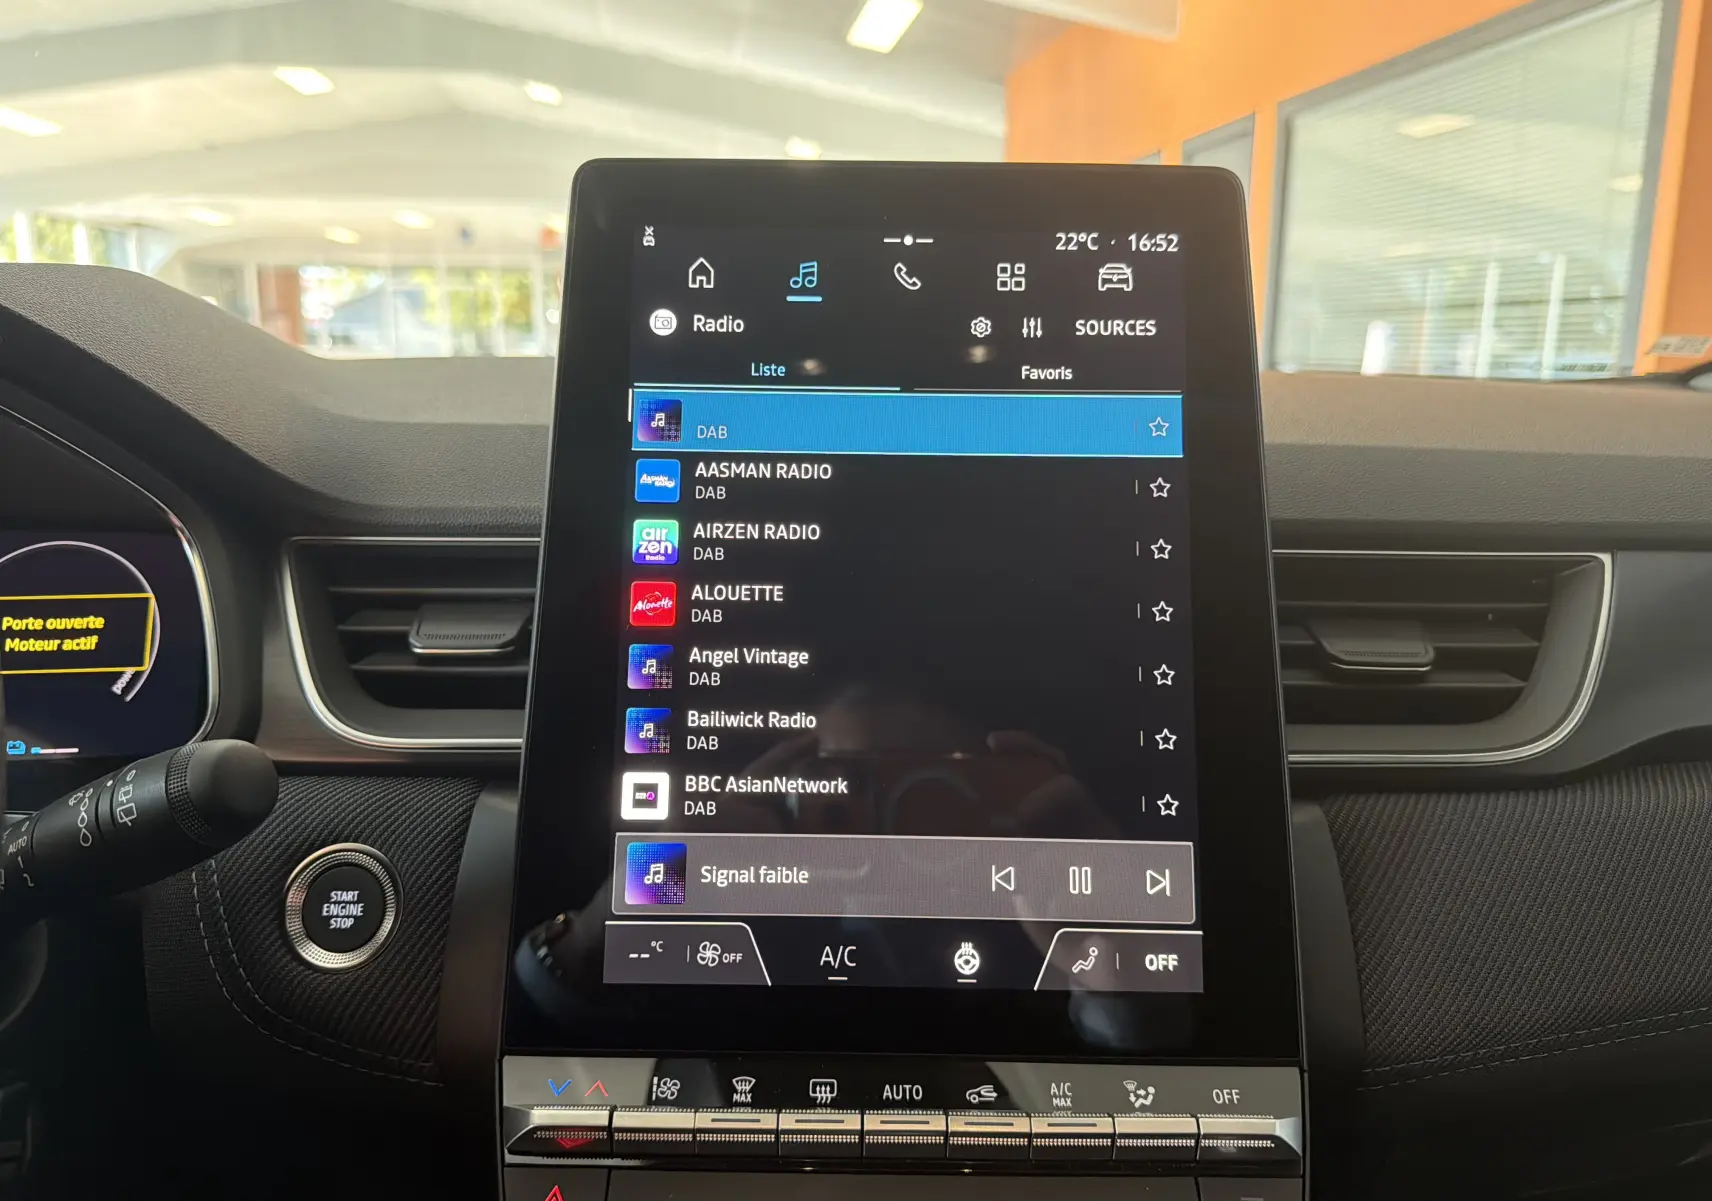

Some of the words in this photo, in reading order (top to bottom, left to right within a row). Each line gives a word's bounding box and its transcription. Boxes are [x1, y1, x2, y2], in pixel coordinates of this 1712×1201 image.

[1055, 233, 1099, 251] 22°C
[1127, 234, 1179, 252] 16:52
[693, 314, 745, 333] Radio
[1075, 319, 1157, 337] SOURCES
[751, 362, 786, 377] Liste
[1021, 365, 1073, 380] Favoris
[697, 425, 728, 439] DAB
[694, 462, 770, 479] AASMAN
[776, 462, 832, 480] RADIO
[695, 485, 726, 500] DAB
[693, 522, 759, 540] AIRZEN
[764, 523, 821, 540] RADIO
[638, 541, 672, 554] zen
[693, 546, 725, 561] DAB
[691, 584, 784, 602] ALOUETTE
[2, 616, 44, 631] Porte
[46, 615, 105, 630] ouverte
[691, 608, 723, 623] DAB
[5, 638, 61, 652] Moteur
[62, 635, 98, 650] actif
[688, 646, 740, 668] Angel
[742, 647, 809, 669] Vintage
[689, 671, 721, 686] DAB
[687, 710, 764, 728] Bailiwick
[768, 711, 817, 729] Radio
[686, 735, 719, 750] DAB
[685, 776, 722, 793] BBC
[725, 776, 848, 794] AsianNetwork
[684, 800, 717, 815] DAB
[7, 835, 28, 856] AUTO
[700, 865, 756, 888] Signal
[758, 866, 809, 884] faible
[329, 890, 360, 902] START
[322, 903, 365, 917] ENGINE
[328, 917, 356, 930] STOP
[722, 953, 743, 964] OFF
[819, 945, 857, 969] A/C
[1144, 953, 1179, 972] OFF
[882, 1083, 923, 1102] AUTO
[1050, 1081, 1073, 1096] A/C
[732, 1092, 753, 1104] MAX
[1052, 1097, 1072, 1107] MAX
[1212, 1088, 1241, 1105] OFF
